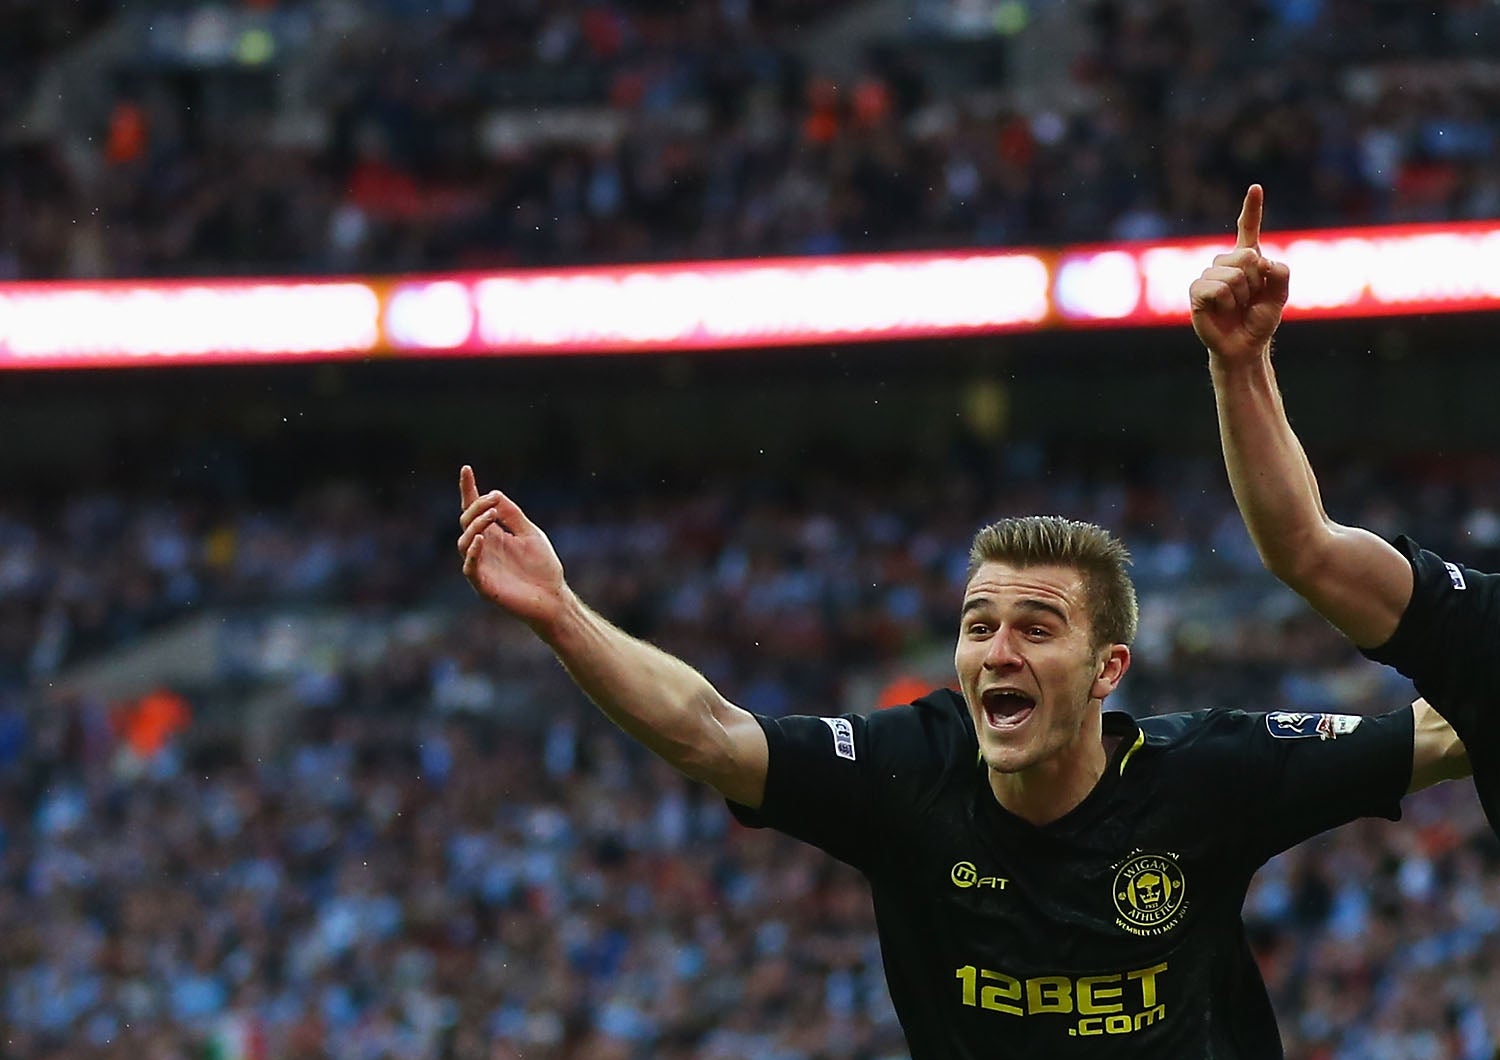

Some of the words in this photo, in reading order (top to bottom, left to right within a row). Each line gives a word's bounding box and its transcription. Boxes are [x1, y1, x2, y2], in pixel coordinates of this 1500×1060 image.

[1123, 859, 1169, 879] WIGAN
[1127, 900, 1176, 922] ATHLETIC
[1115, 917, 1151, 936] WEMBLEY
[1162, 918, 1178, 933] MAY
[955, 961, 1168, 1017] 12BET
[1068, 1003, 1166, 1037] .com
